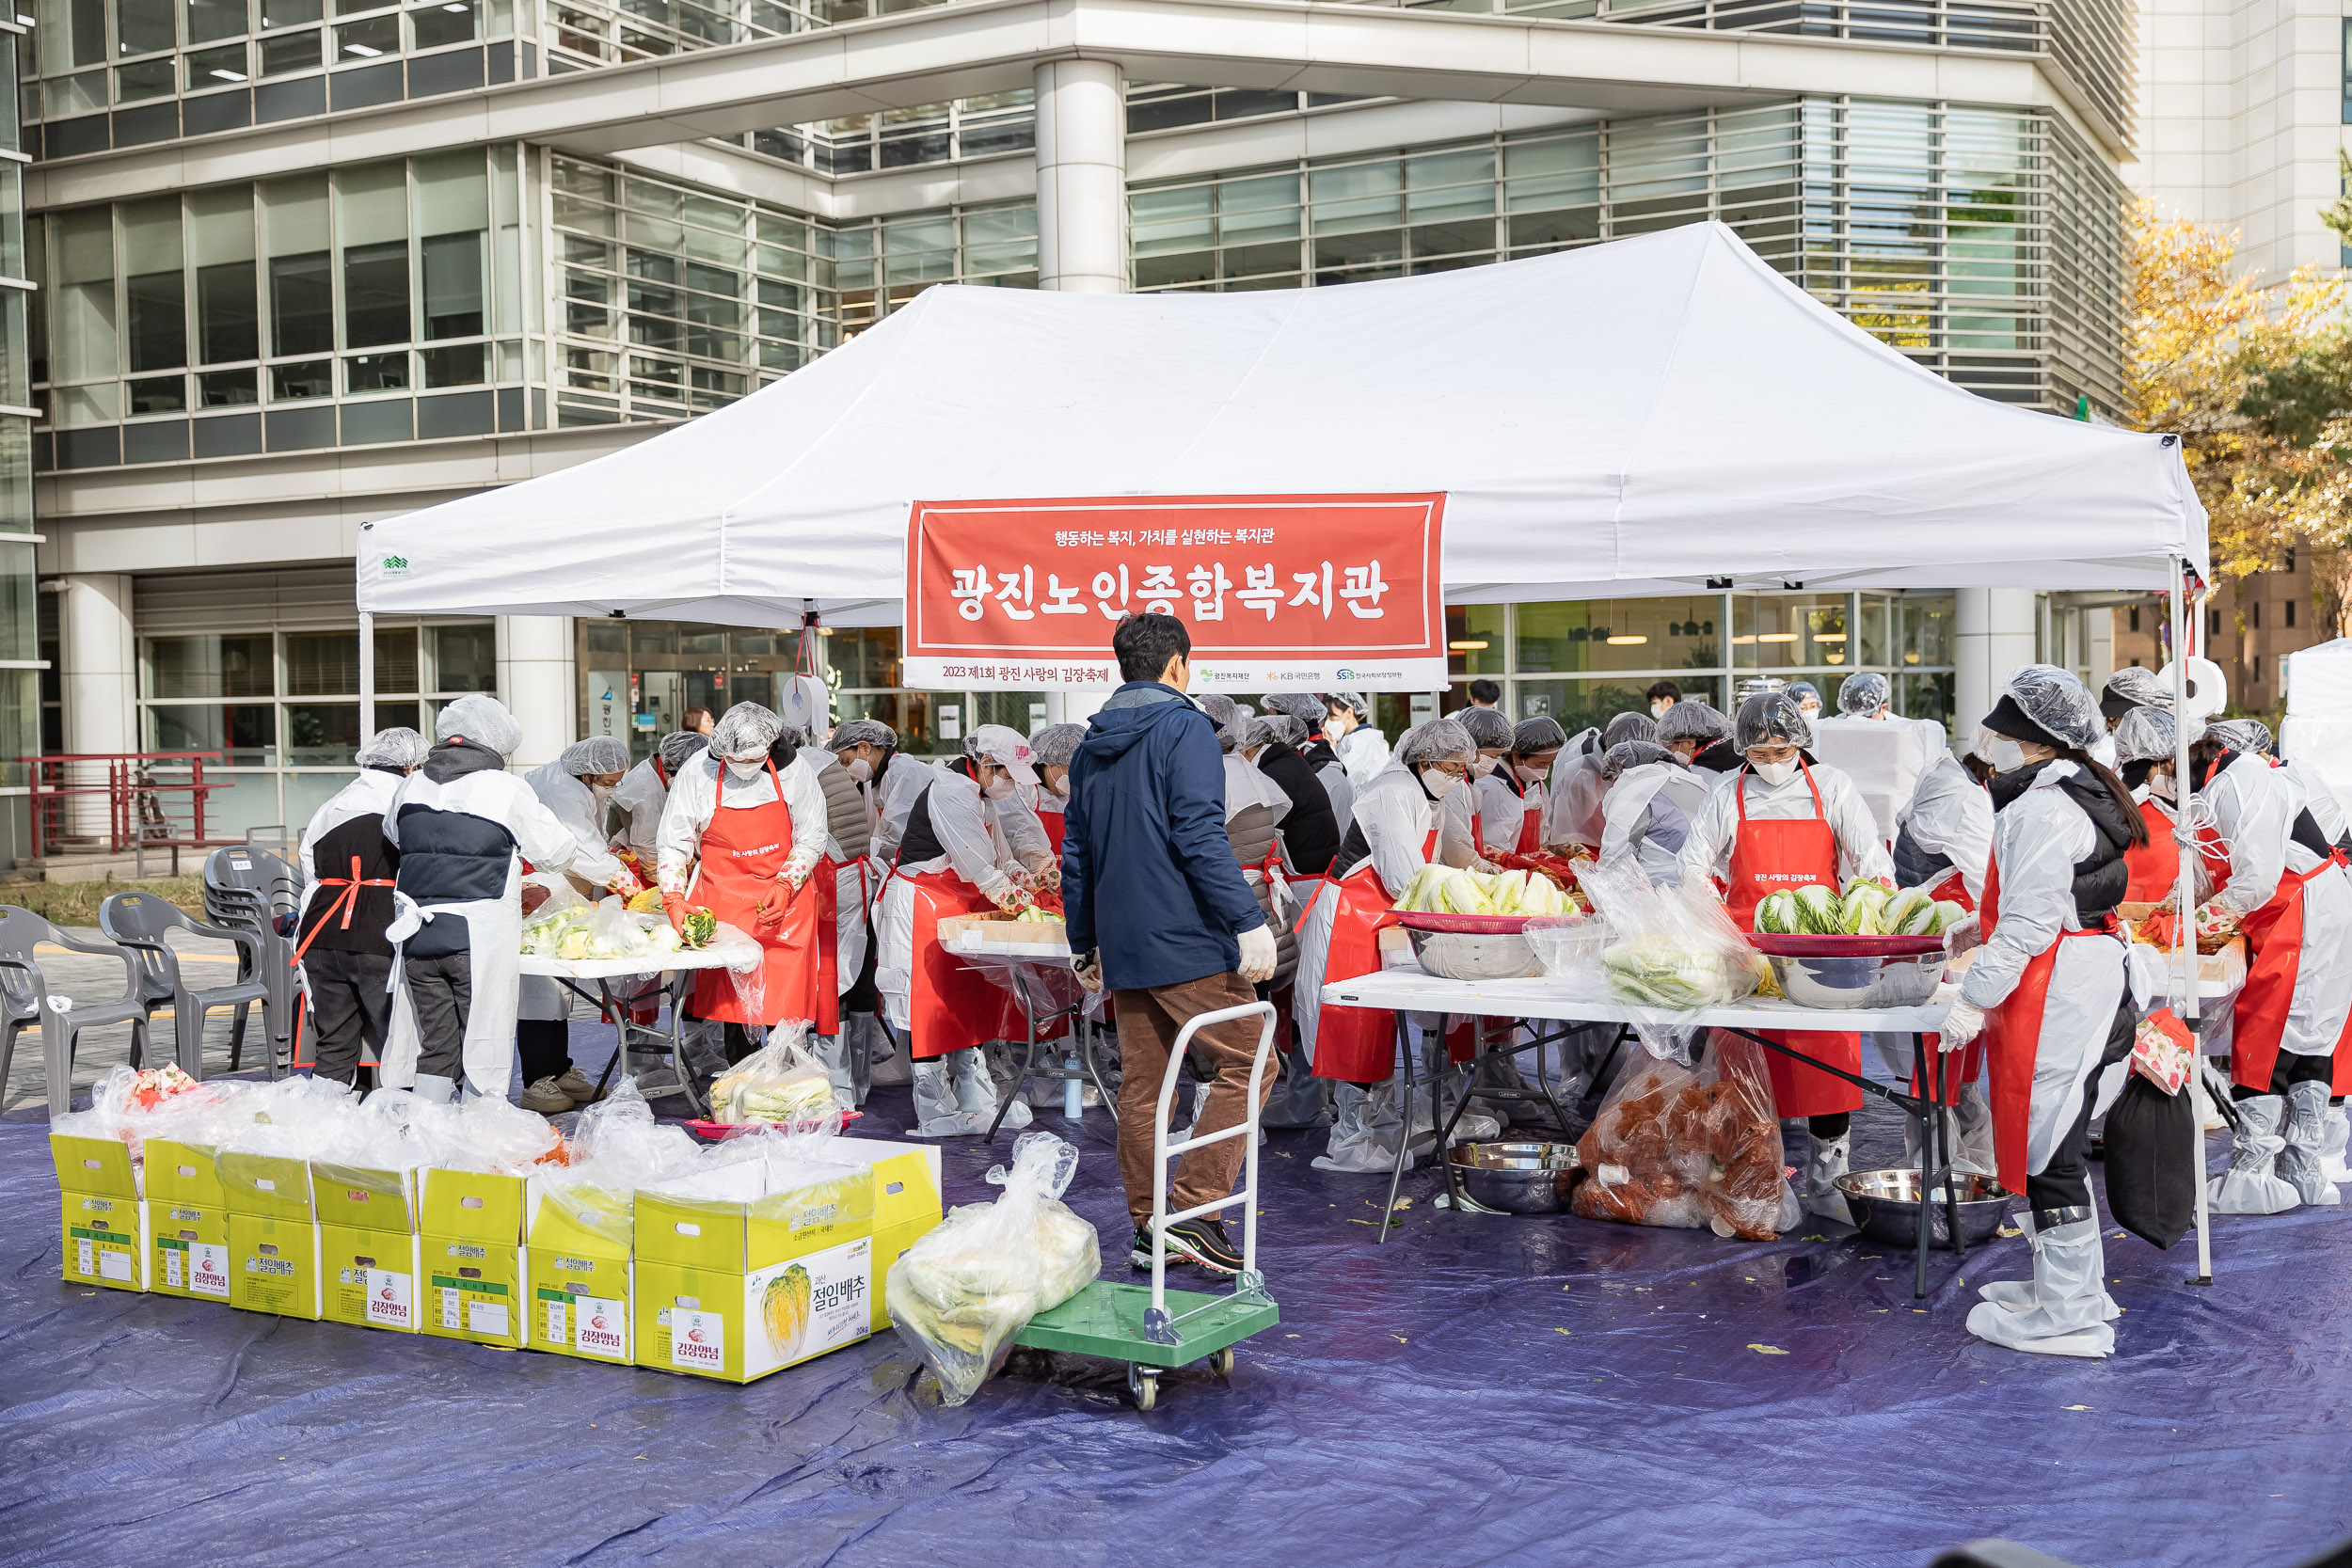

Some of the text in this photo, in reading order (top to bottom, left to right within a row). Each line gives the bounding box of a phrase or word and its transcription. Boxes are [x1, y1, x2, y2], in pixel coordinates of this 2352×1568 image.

[1055, 528, 1275, 547] 행동하는 복지, 가치를 실현하는 복지관
[950, 560, 1390, 622] 광진노인종합복지관
[943, 666, 1109, 683] 2023 제1회 광진 사랑의 김장축제
[1294, 672, 1320, 680] 국민은행
[1754, 873, 1817, 882] 광진 사랑의 김장축제
[91, 1199, 113, 1212] 절임배추
[179, 1209, 201, 1222] 절임배추
[803, 1203, 836, 1227] 절임배추
[820, 1224, 834, 1233] 국내산
[458, 1244, 486, 1259] 절임배추
[259, 1258, 294, 1276] 절임배추
[565, 1258, 596, 1272] 절임배추
[194, 1271, 225, 1287] 김장양념
[815, 1274, 826, 1286] 괴산
[813, 1275, 866, 1312] 절임배추
[372, 1300, 407, 1317] 김장양념
[580, 1329, 620, 1346] 김장양념
[856, 1326, 868, 1336] 20kg
[677, 1341, 719, 1360] 김장양념
